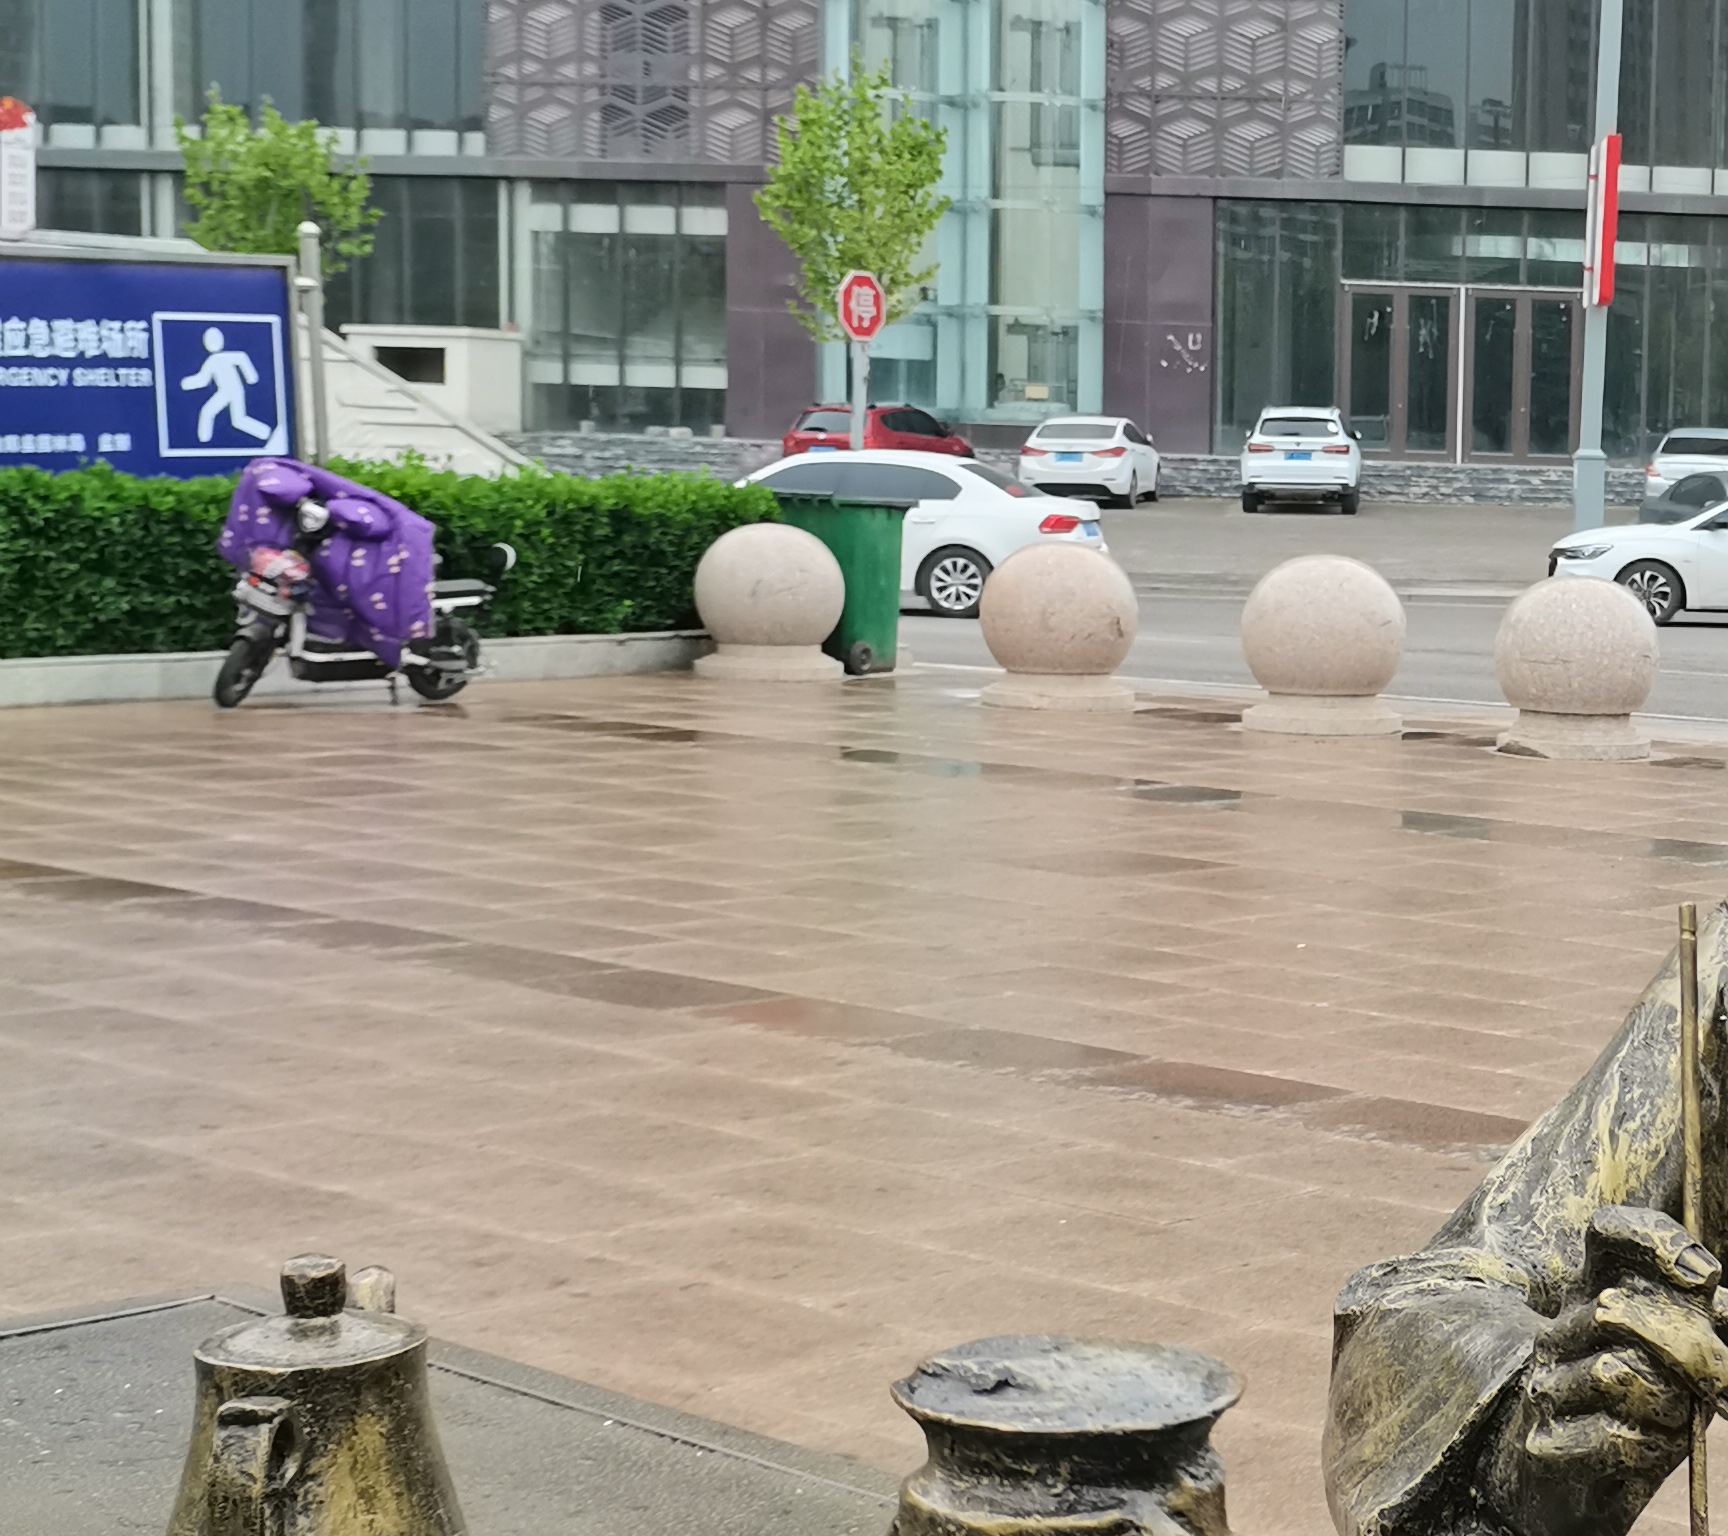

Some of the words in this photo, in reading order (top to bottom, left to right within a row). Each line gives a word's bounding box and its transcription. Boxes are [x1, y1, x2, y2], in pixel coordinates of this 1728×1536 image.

[849, 284, 877, 328] 停
[0, 316, 149, 359] 应急避难场所
[72, 367, 153, 387] SHELTER
